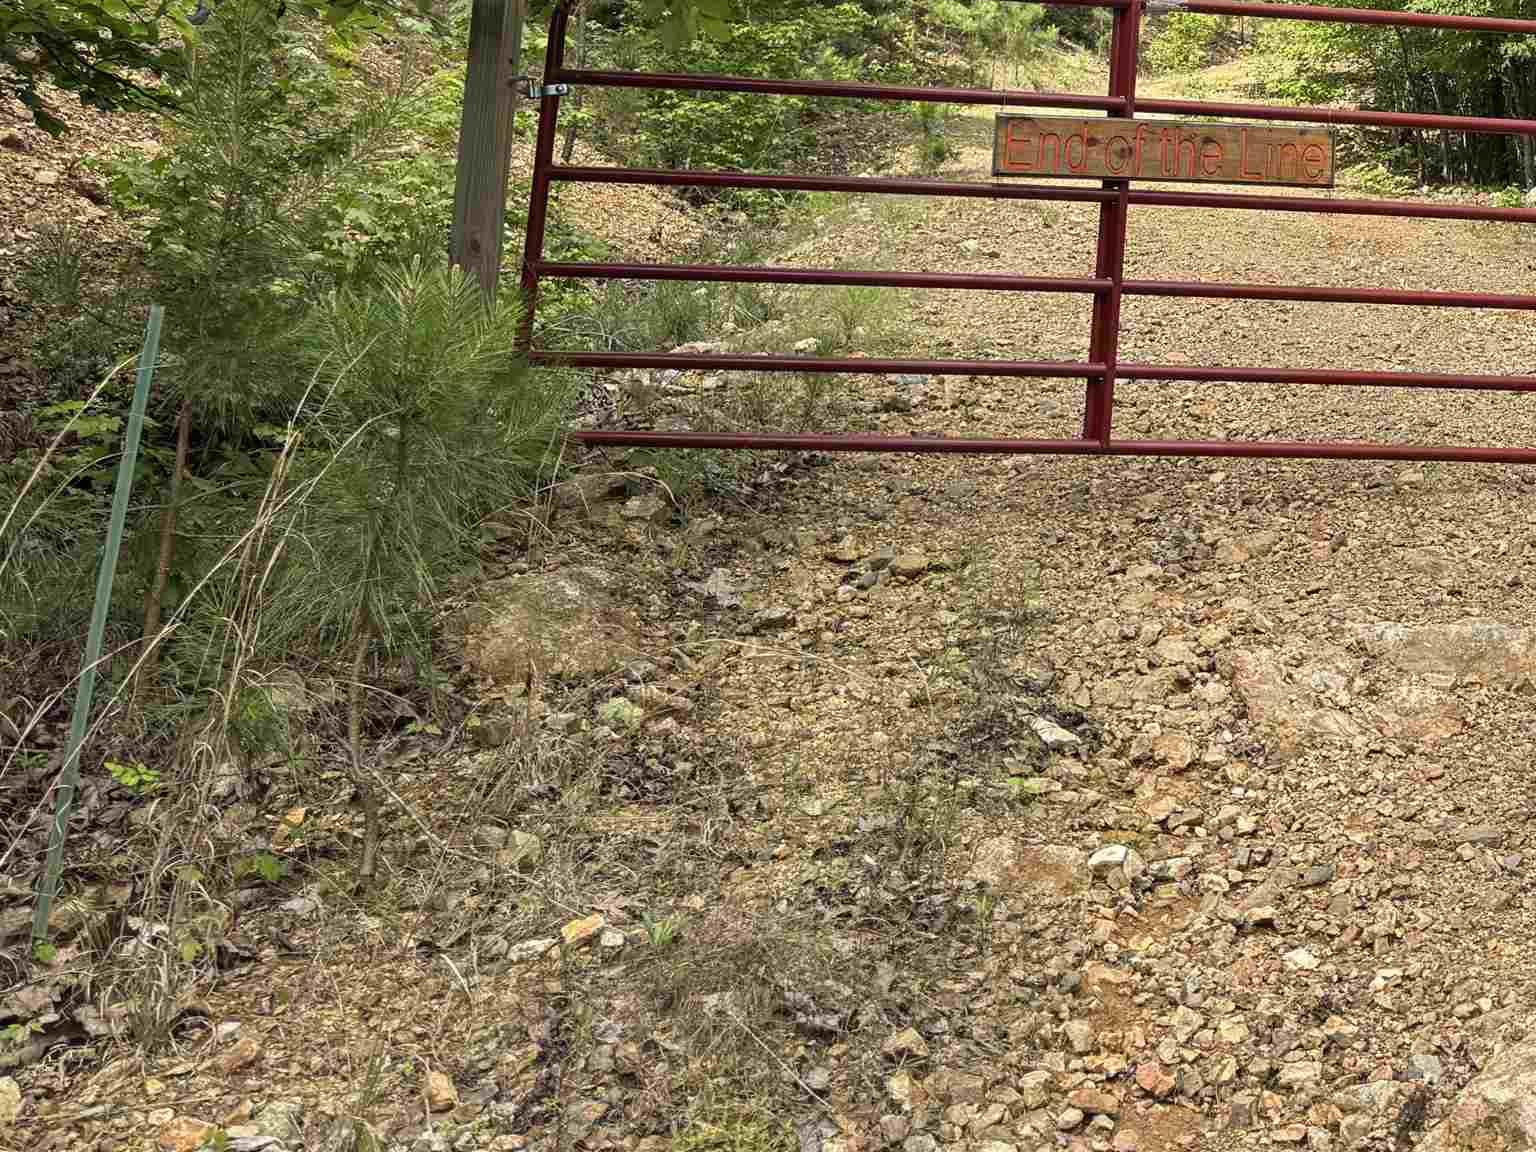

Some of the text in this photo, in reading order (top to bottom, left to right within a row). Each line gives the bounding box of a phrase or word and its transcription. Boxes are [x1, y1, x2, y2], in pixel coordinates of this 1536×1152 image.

[1003, 119, 1327, 182] End of the Line
